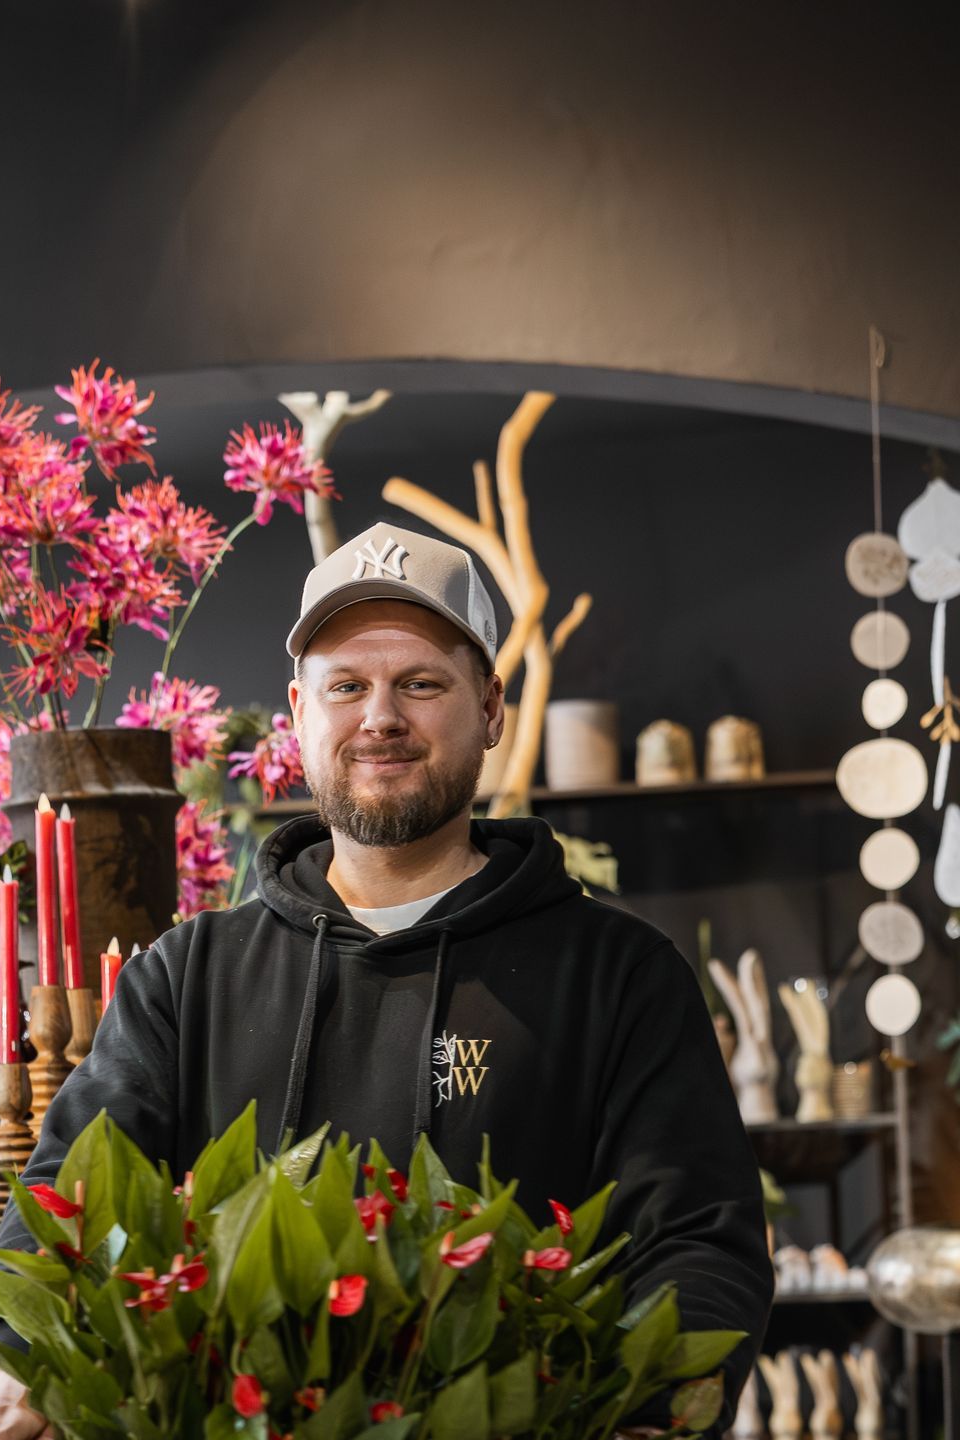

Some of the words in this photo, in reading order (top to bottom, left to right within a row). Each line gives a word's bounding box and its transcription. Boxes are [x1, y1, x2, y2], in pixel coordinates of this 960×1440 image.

[352, 537, 406, 580] NY
[455, 1039, 492, 1067] W
[452, 1066, 490, 1096] W
